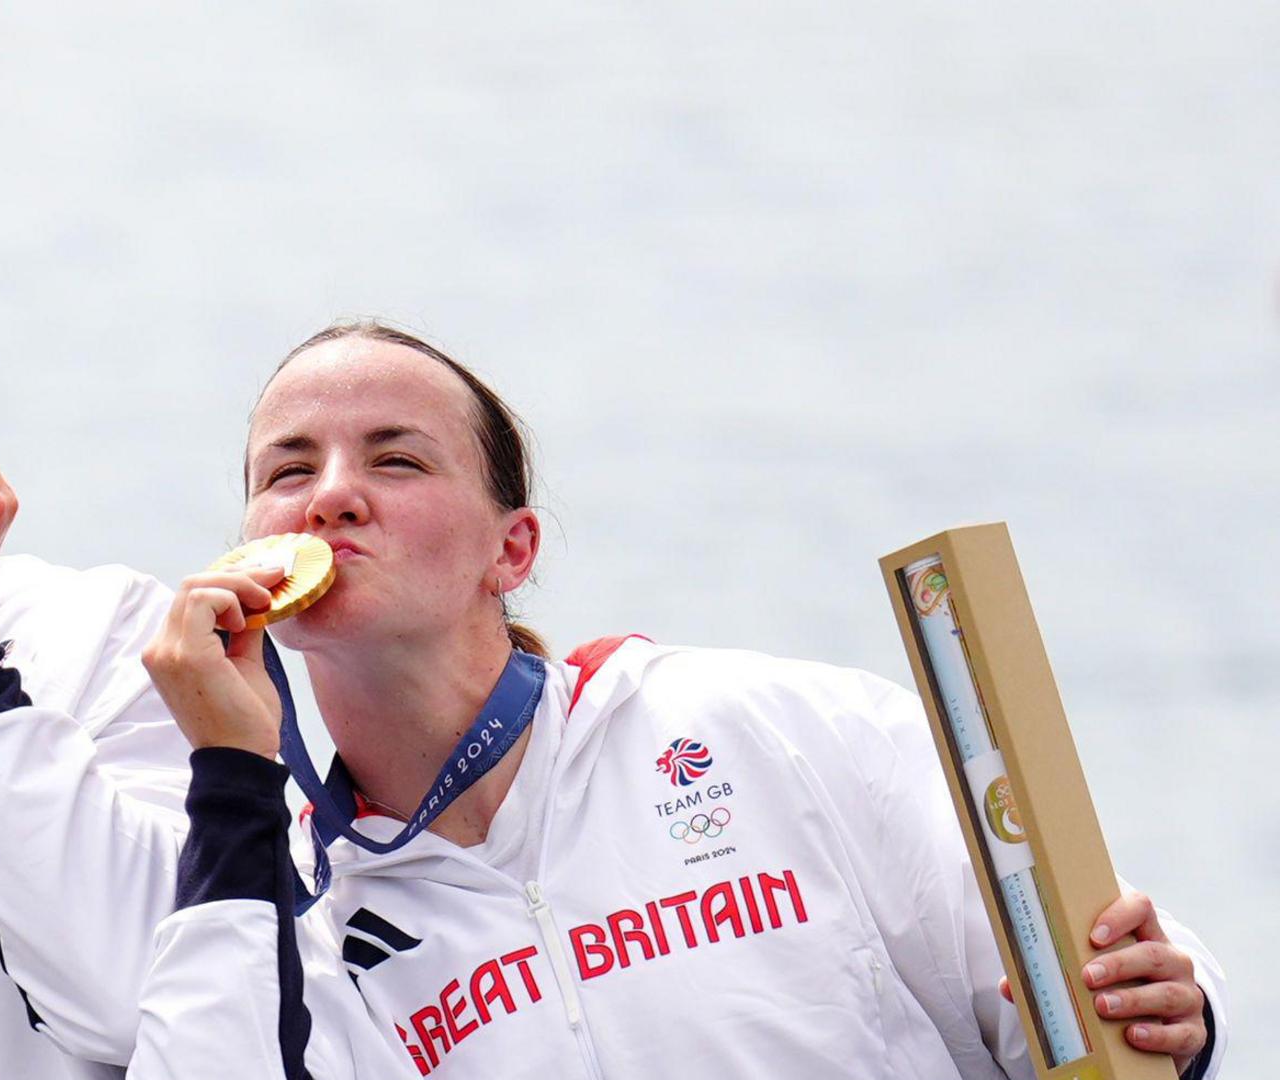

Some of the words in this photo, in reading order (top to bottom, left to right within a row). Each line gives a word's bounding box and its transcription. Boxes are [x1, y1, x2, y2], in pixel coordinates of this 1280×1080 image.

[408, 774, 453, 836] PARIS
[457, 718, 503, 773] 2024
[654, 791, 702, 817] TEAM
[707, 782, 733, 799] GB
[684, 852, 710, 866] PARIS
[711, 846, 736, 858] 2024
[568, 869, 808, 981] BRITAIN
